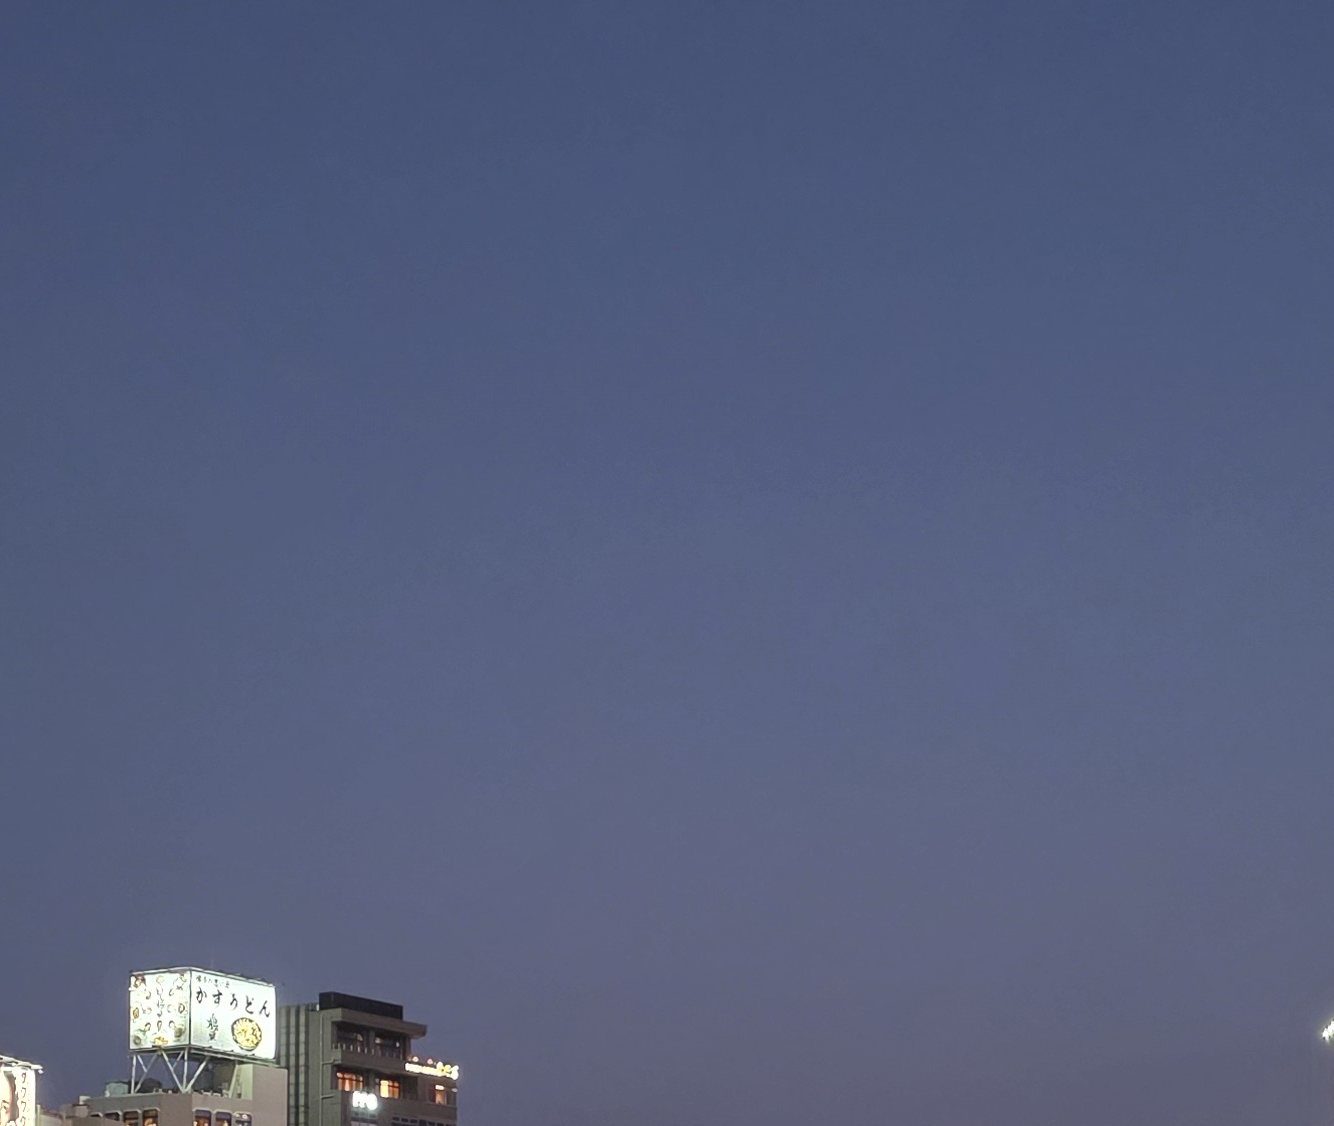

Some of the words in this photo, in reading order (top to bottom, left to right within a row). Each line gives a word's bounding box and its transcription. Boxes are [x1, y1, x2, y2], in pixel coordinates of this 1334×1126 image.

[196, 986, 272, 1018] かすうどん
